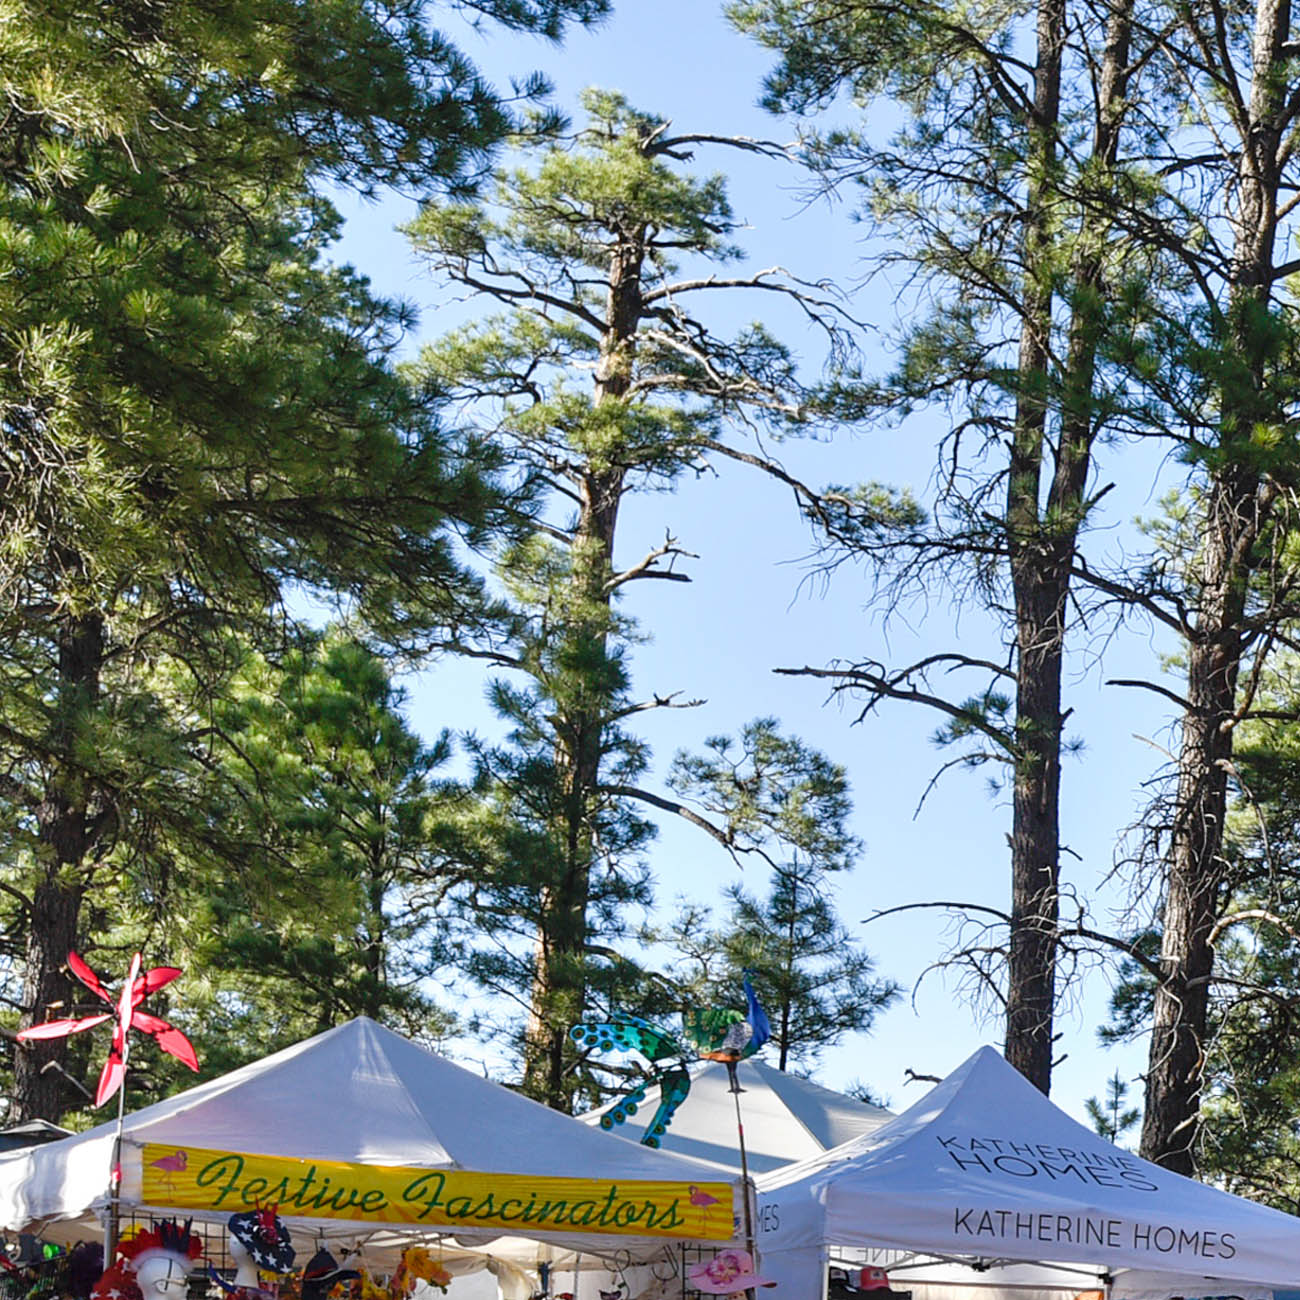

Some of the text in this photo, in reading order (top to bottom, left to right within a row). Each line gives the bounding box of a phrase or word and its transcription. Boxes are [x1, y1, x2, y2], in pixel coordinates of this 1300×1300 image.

[936, 1135, 1143, 1172] KATHERINE
[948, 1151, 1159, 1192] HOMES
[196, 1155, 686, 1230] Festive Fascinators
[954, 1207, 1237, 1260] KATHERINE HOMES
